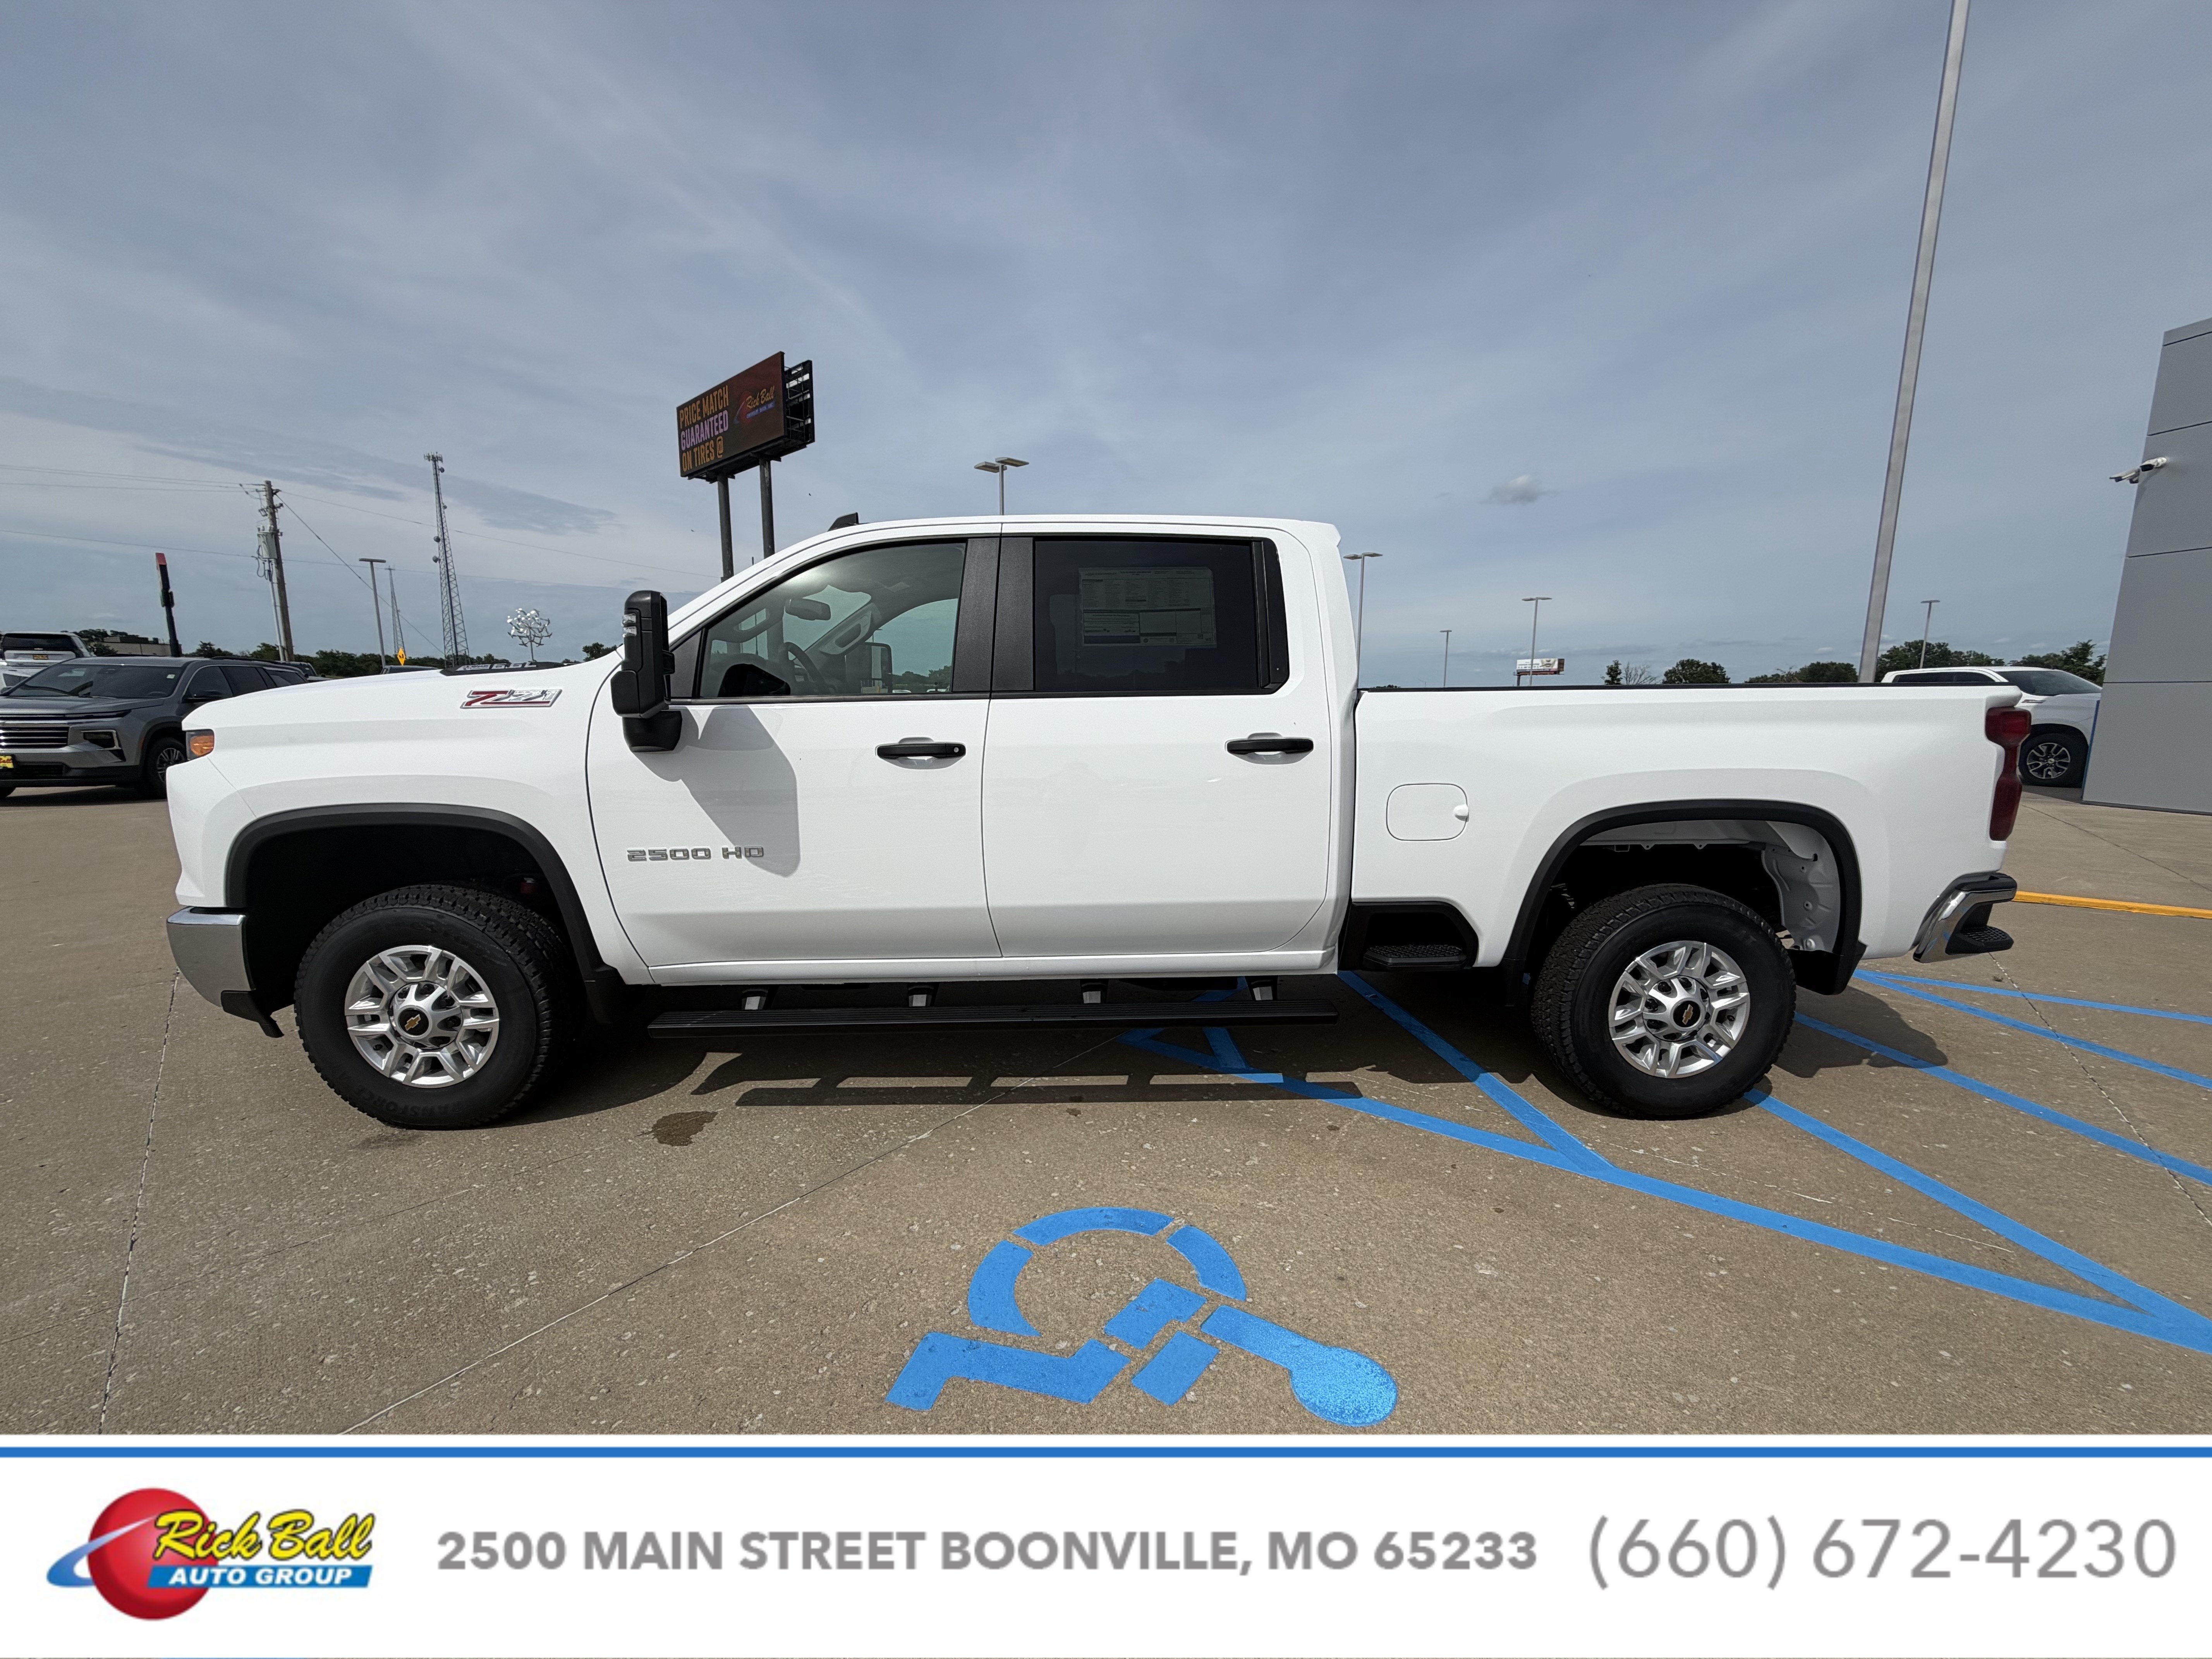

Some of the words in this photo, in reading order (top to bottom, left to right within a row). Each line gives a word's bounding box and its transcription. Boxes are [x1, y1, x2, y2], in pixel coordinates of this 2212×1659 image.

[680, 400, 701, 429] PRICE
[702, 385, 729, 418] MATCH
[746, 392, 759, 409] Rick
[760, 385, 775, 404] Ball
[681, 410, 728, 451] GUARANTEED
[682, 450, 692, 472] ON
[693, 440, 715, 467] TIRES
[716, 436, 724, 459] @
[460, 689, 562, 709] Z71
[627, 847, 711, 862] 2500
[721, 846, 764, 859] HD
